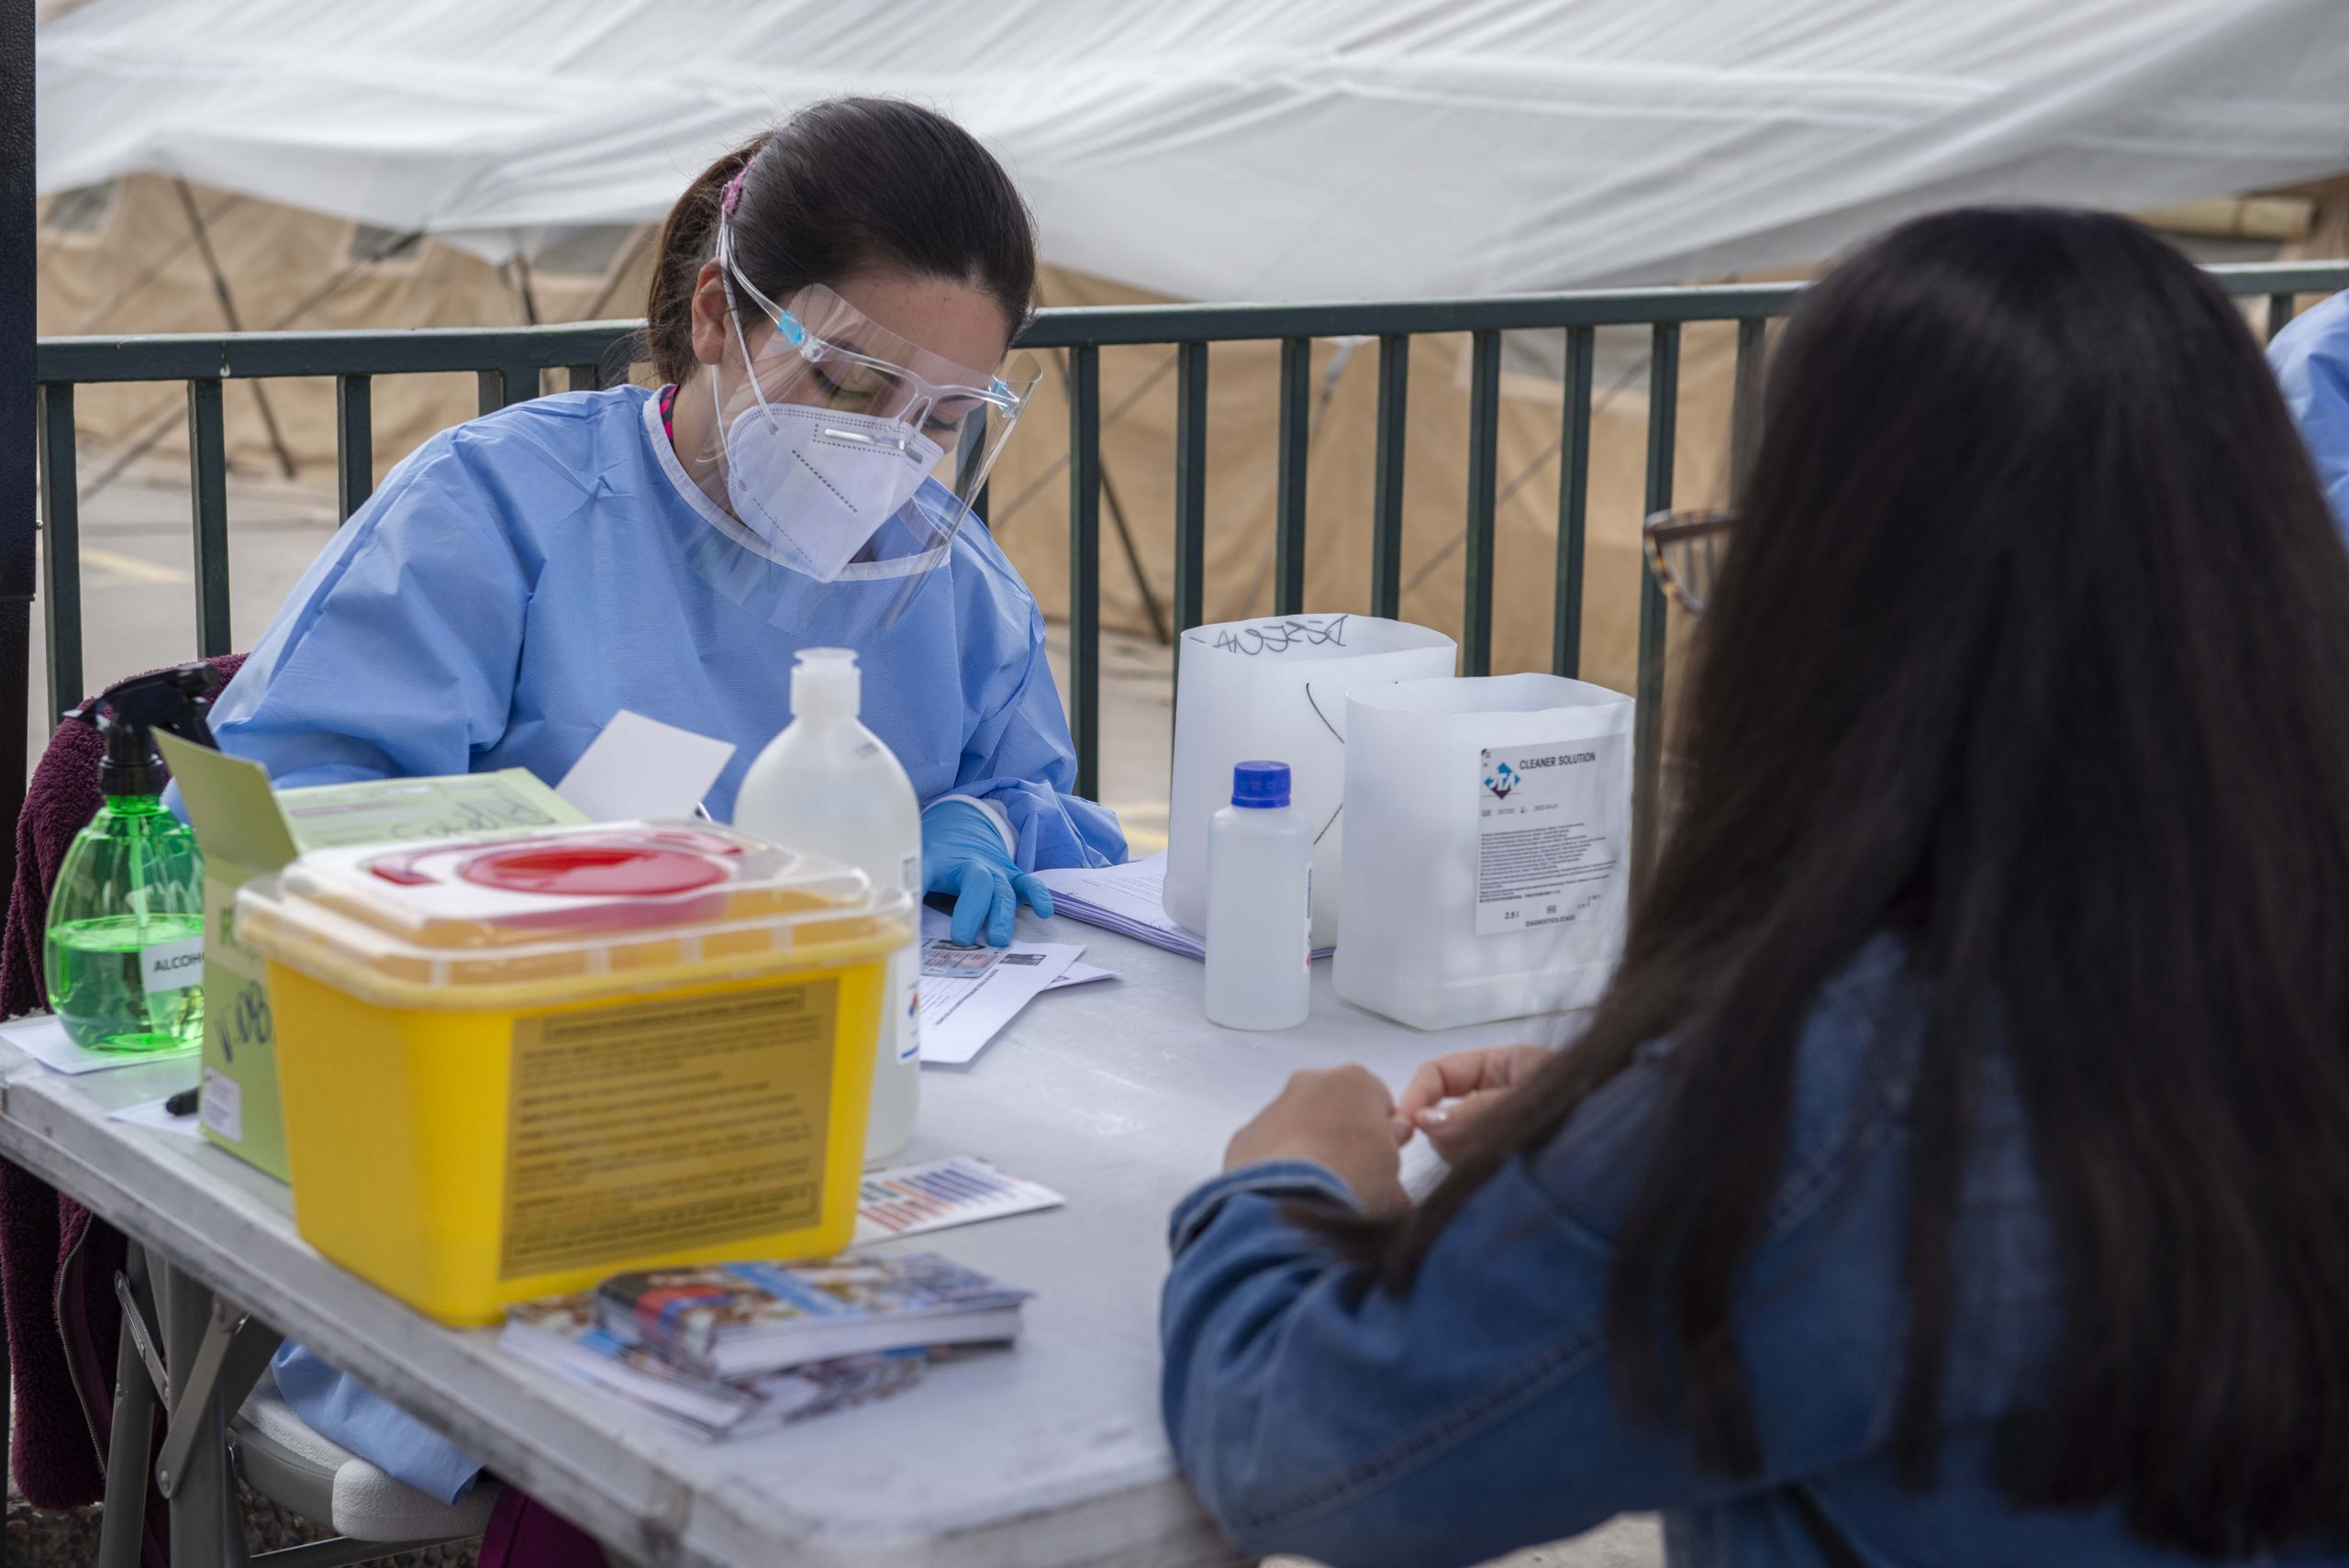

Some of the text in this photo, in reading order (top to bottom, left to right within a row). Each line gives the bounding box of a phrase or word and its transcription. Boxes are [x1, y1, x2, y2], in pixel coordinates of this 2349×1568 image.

[1520, 751, 1596, 771] CLEANER SOLUTION
[153, 951, 206, 973] ALCOH
